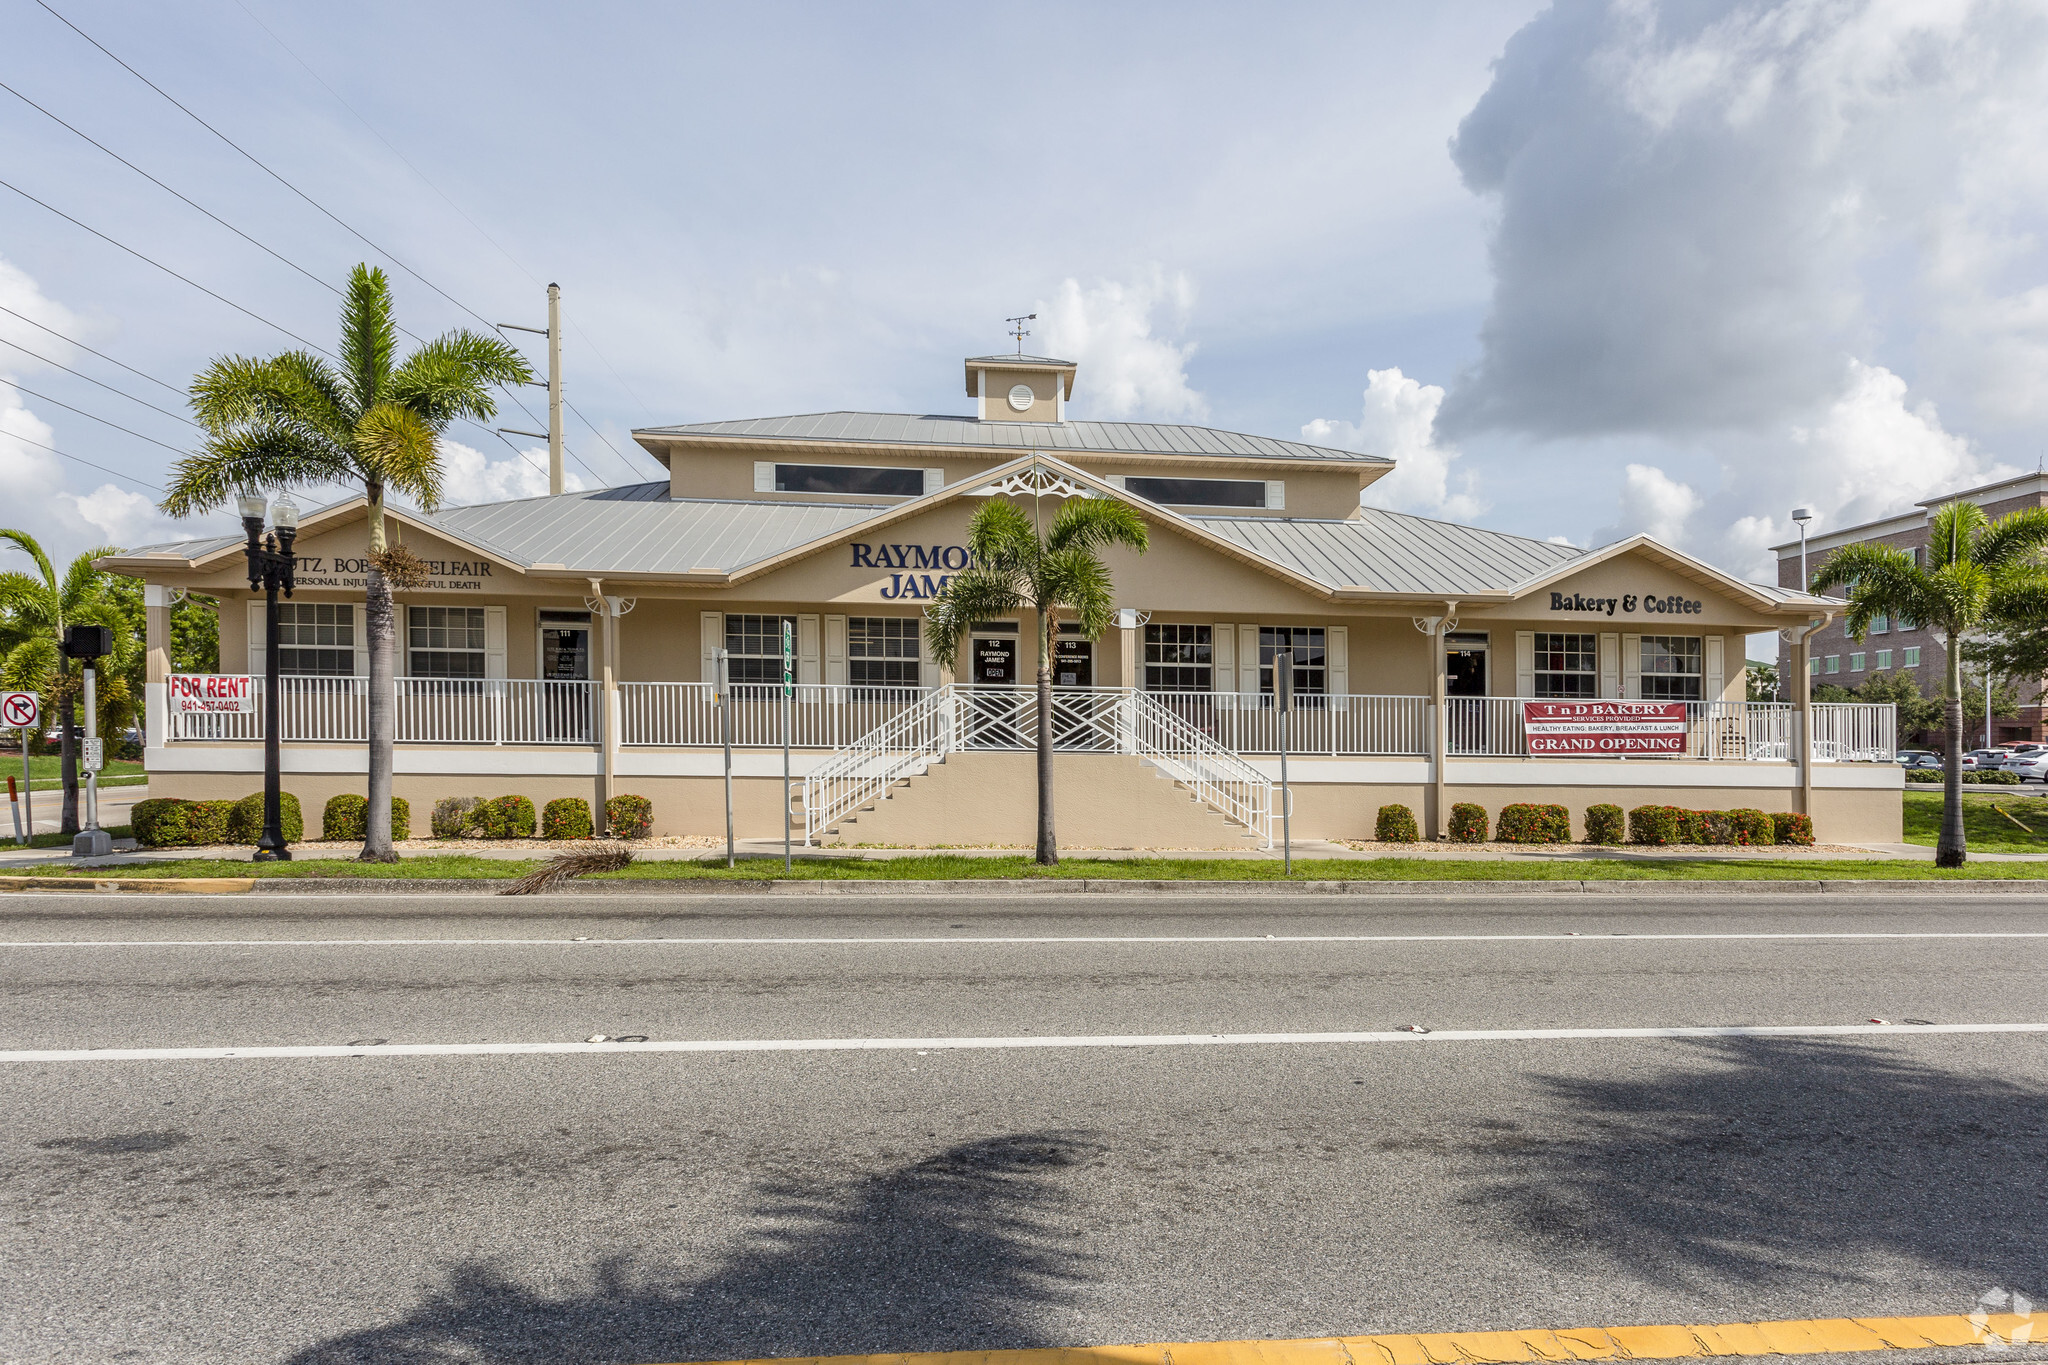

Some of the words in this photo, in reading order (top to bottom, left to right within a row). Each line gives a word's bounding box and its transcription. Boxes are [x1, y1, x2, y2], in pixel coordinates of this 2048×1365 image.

[292, 557, 327, 574] TZ,
[850, 543, 992, 571] RAYMON
[343, 578, 368, 588] INJU
[449, 581, 481, 589] DEATH
[880, 574, 960, 600] JAM
[1550, 592, 1617, 616] Bakery
[1622, 594, 1638, 612] &
[1643, 595, 1702, 614] Coffee
[171, 677, 202, 697] FOR
[207, 677, 249, 698] RENT
[181, 700, 240, 711] 941-457-0402
[1544, 705, 1556, 715] T
[1575, 705, 1588, 715] D
[1592, 705, 1668, 715] BAKERY
[1531, 738, 1595, 750] GRAND
[1599, 738, 1680, 750] OPENING
